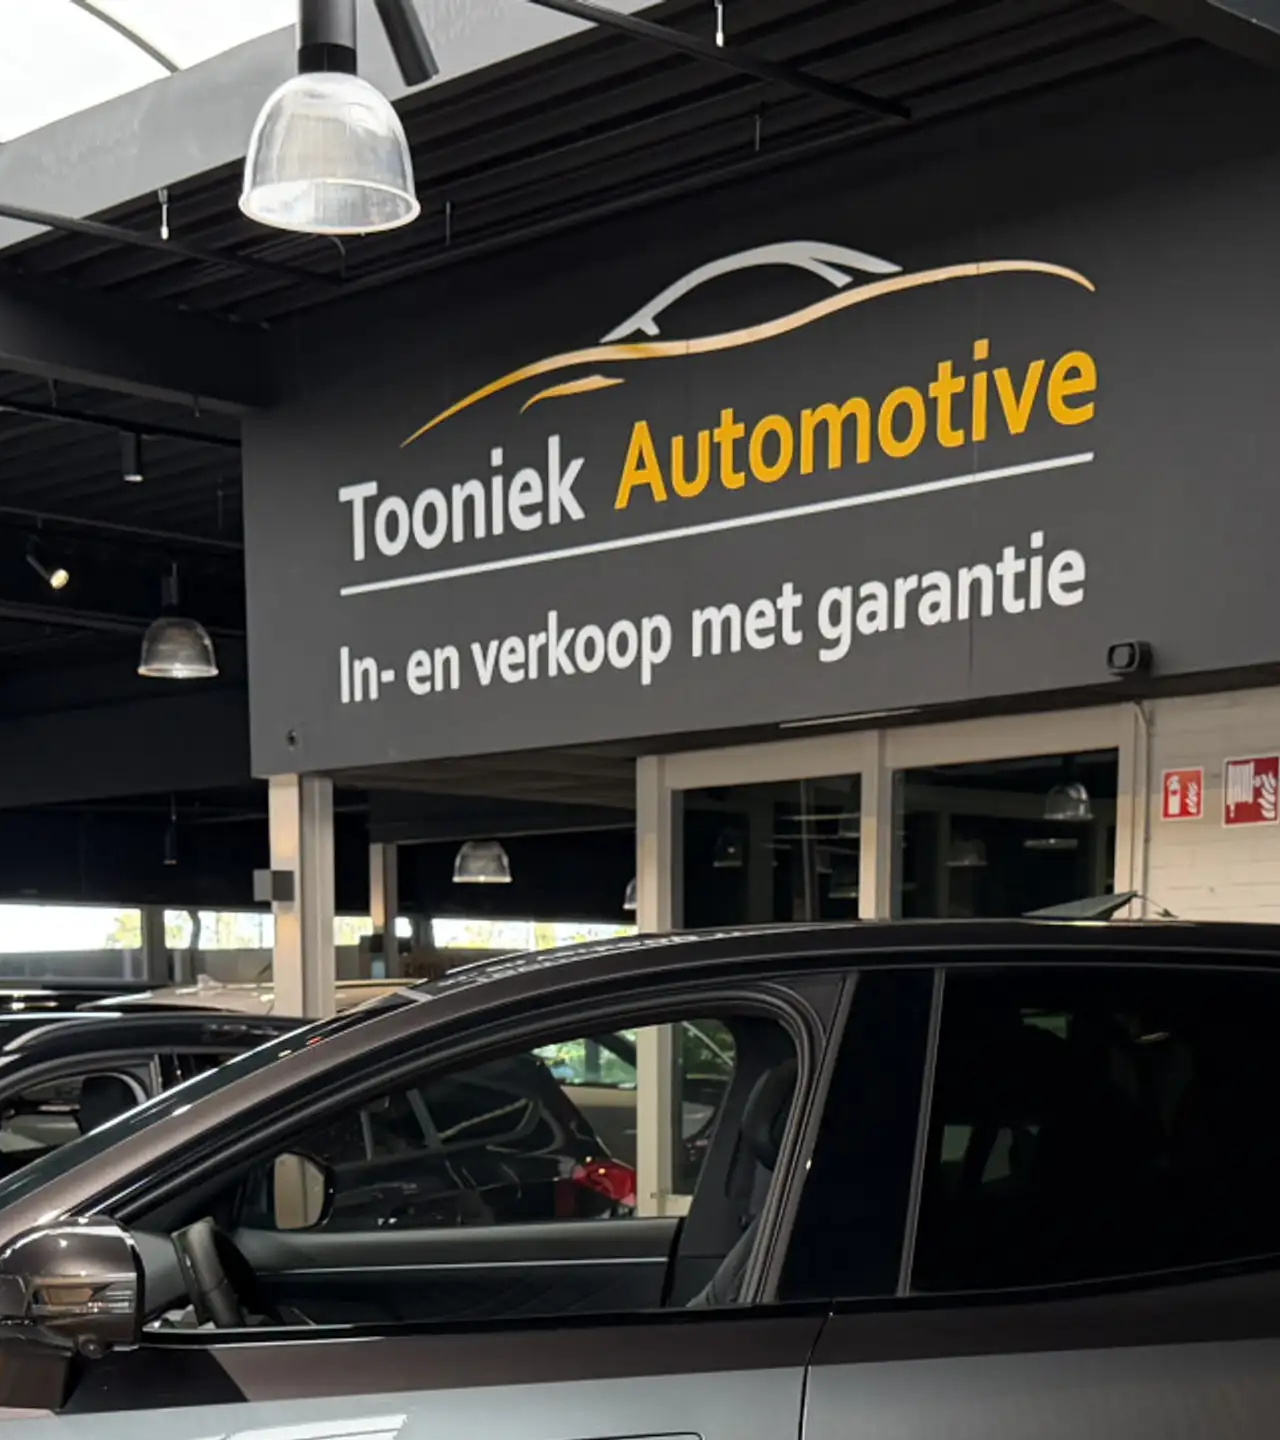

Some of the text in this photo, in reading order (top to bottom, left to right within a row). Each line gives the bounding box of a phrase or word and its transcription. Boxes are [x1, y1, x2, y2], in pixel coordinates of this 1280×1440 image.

[338, 339, 1097, 561] Tooniek Automotive
[339, 530, 1086, 704] In- en verkoop met garantie
